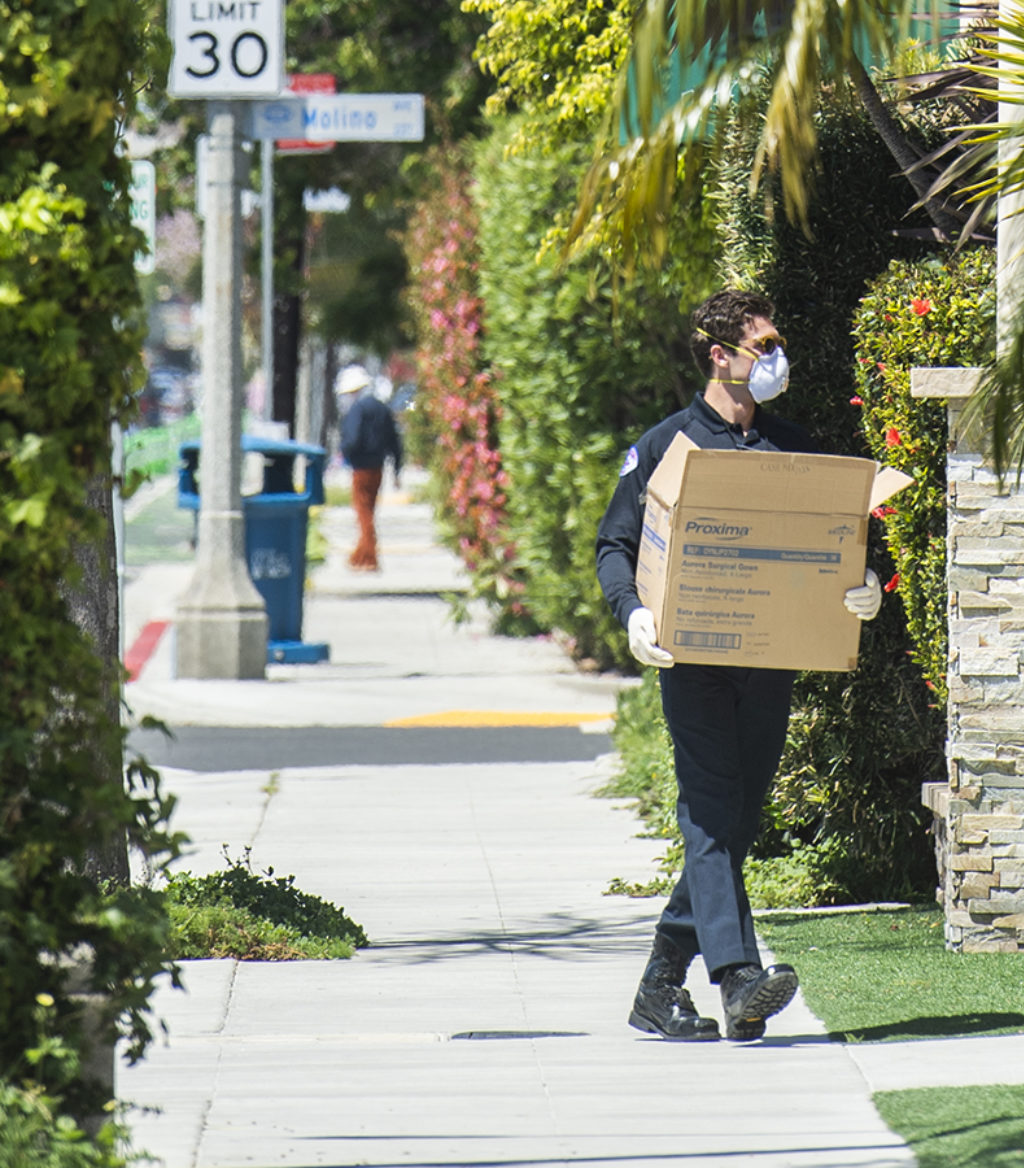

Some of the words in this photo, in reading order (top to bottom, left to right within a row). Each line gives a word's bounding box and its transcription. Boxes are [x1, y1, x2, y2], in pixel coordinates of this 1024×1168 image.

[190, 1, 261, 22] LIMIT
[184, 30, 269, 79] 30
[303, 106, 378, 130] Molino
[685, 520, 751, 537] Proxima
